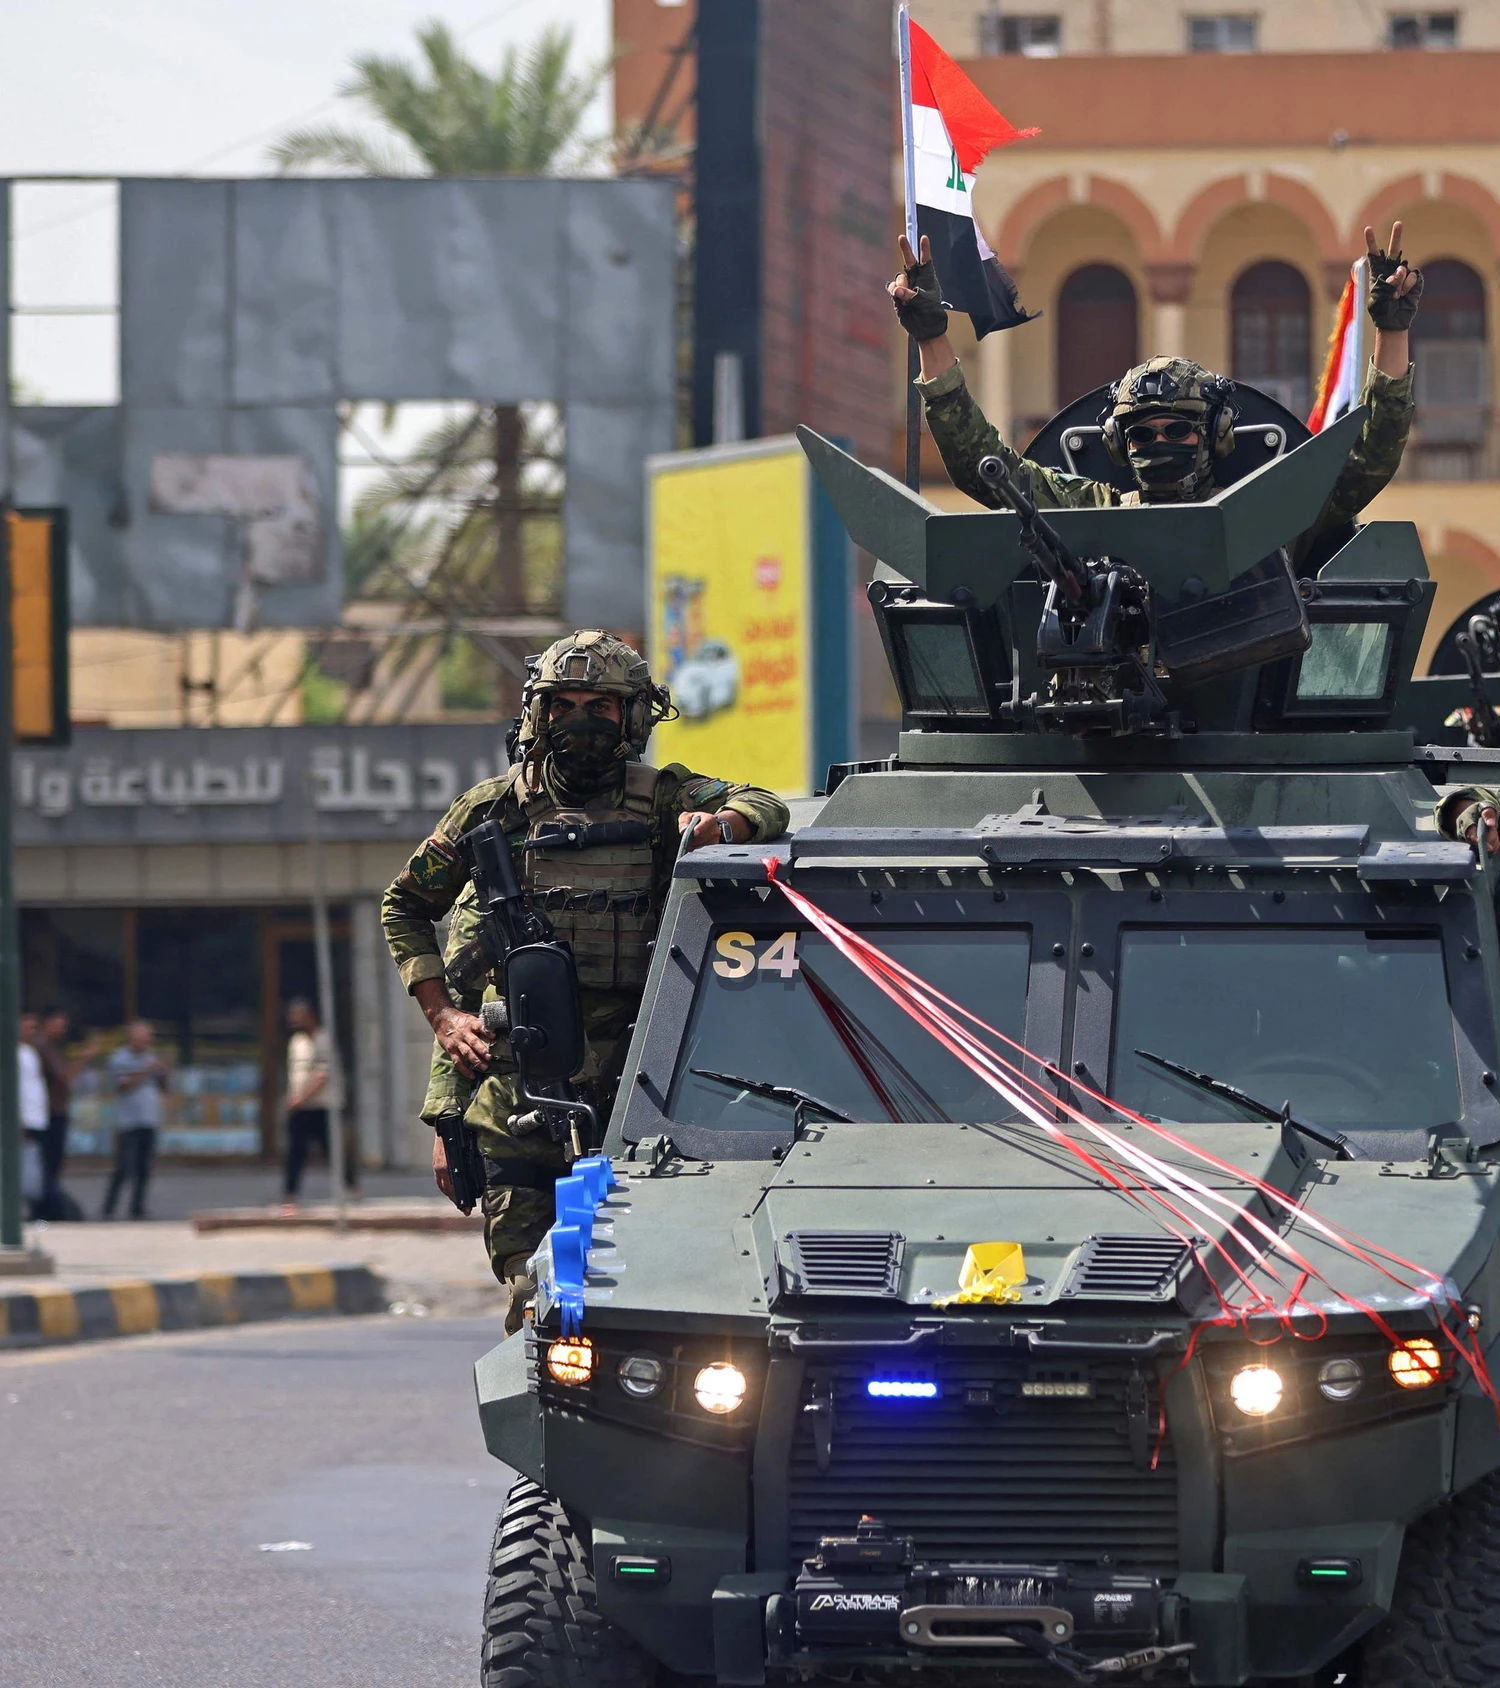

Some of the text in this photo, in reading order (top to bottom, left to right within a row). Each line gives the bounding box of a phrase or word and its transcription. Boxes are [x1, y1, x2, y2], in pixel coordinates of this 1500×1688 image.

[80, 757, 285, 814] للطباعة
[313, 746, 456, 824] دجلة
[712, 931, 800, 978] S4
[836, 1601, 898, 1611] ARMOUR
